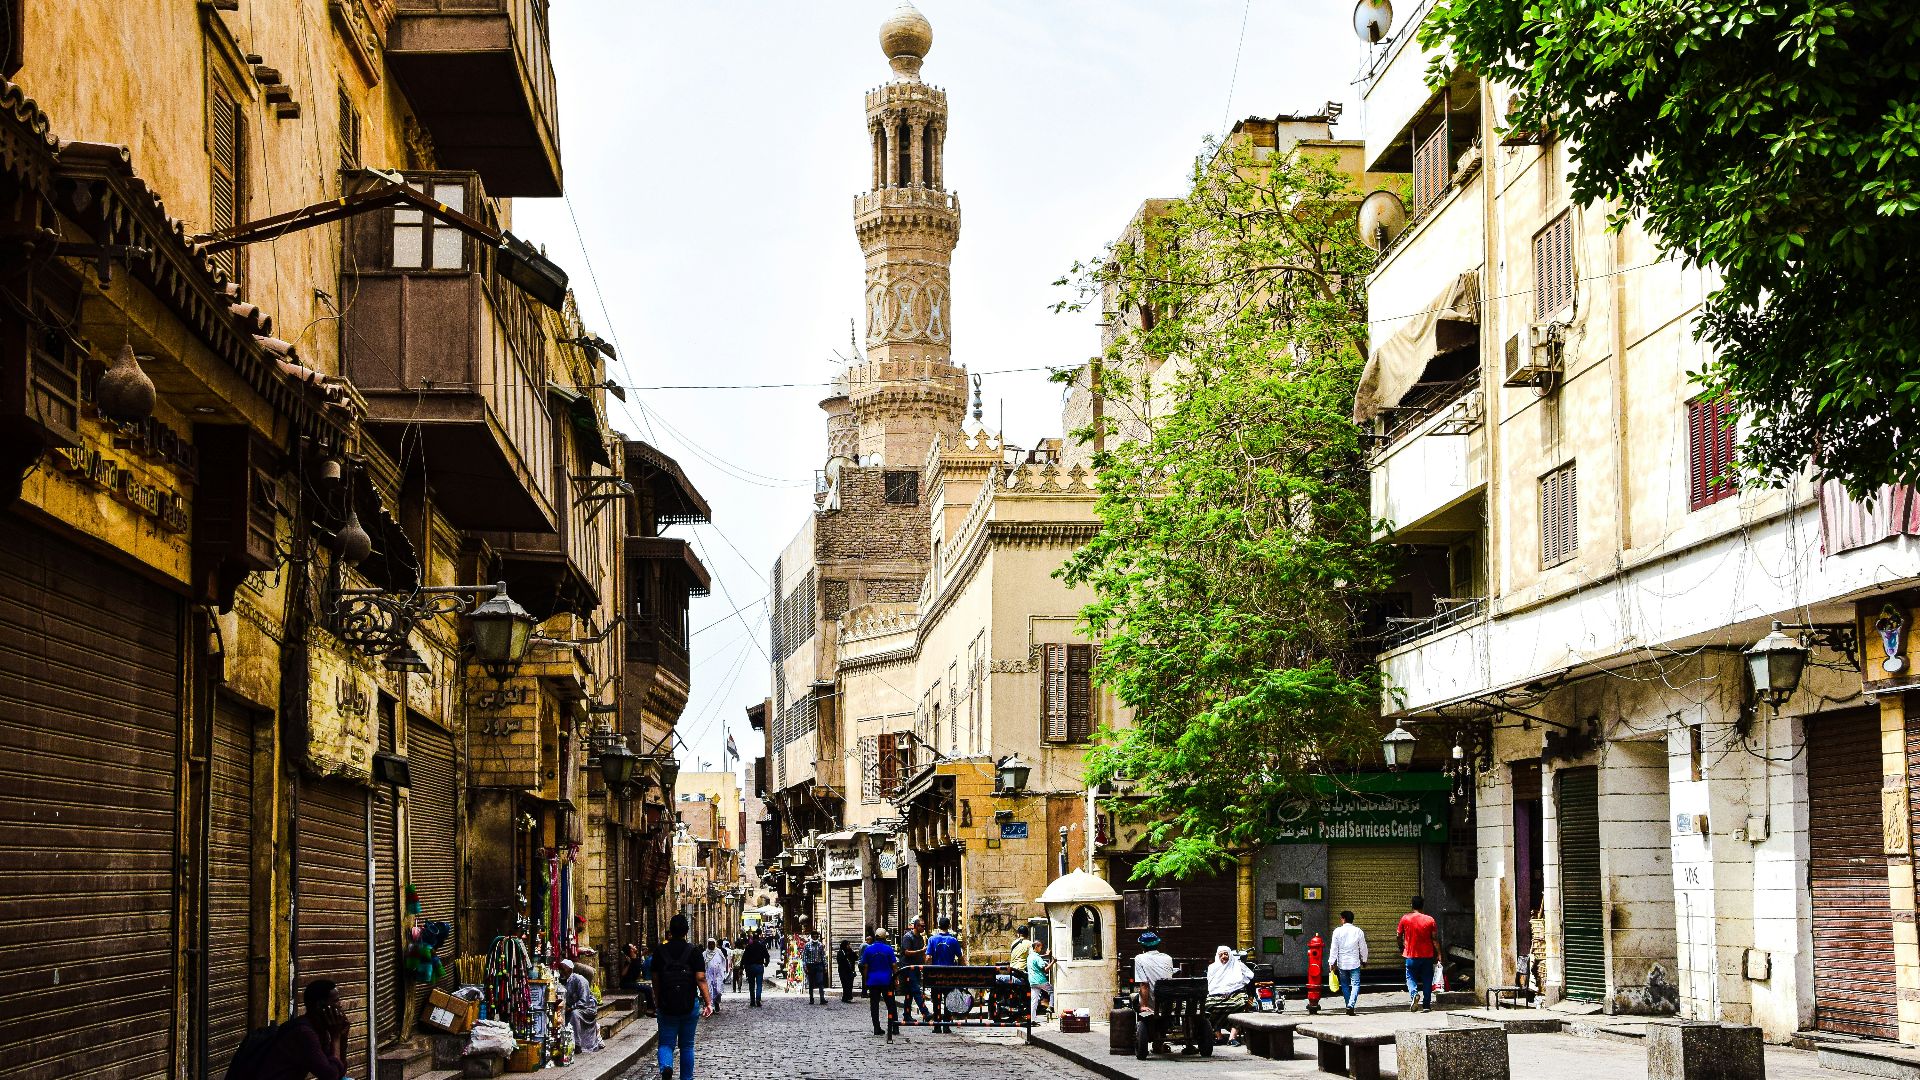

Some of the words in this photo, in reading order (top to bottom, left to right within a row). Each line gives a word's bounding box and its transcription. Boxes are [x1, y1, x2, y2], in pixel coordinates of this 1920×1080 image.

[1360, 799, 1398, 812] الخدمات
[1397, 799, 1421, 813] مركز
[1318, 820, 1348, 838] Postal
[1349, 820, 1390, 838] Services
[1391, 819, 1423, 838] Center
